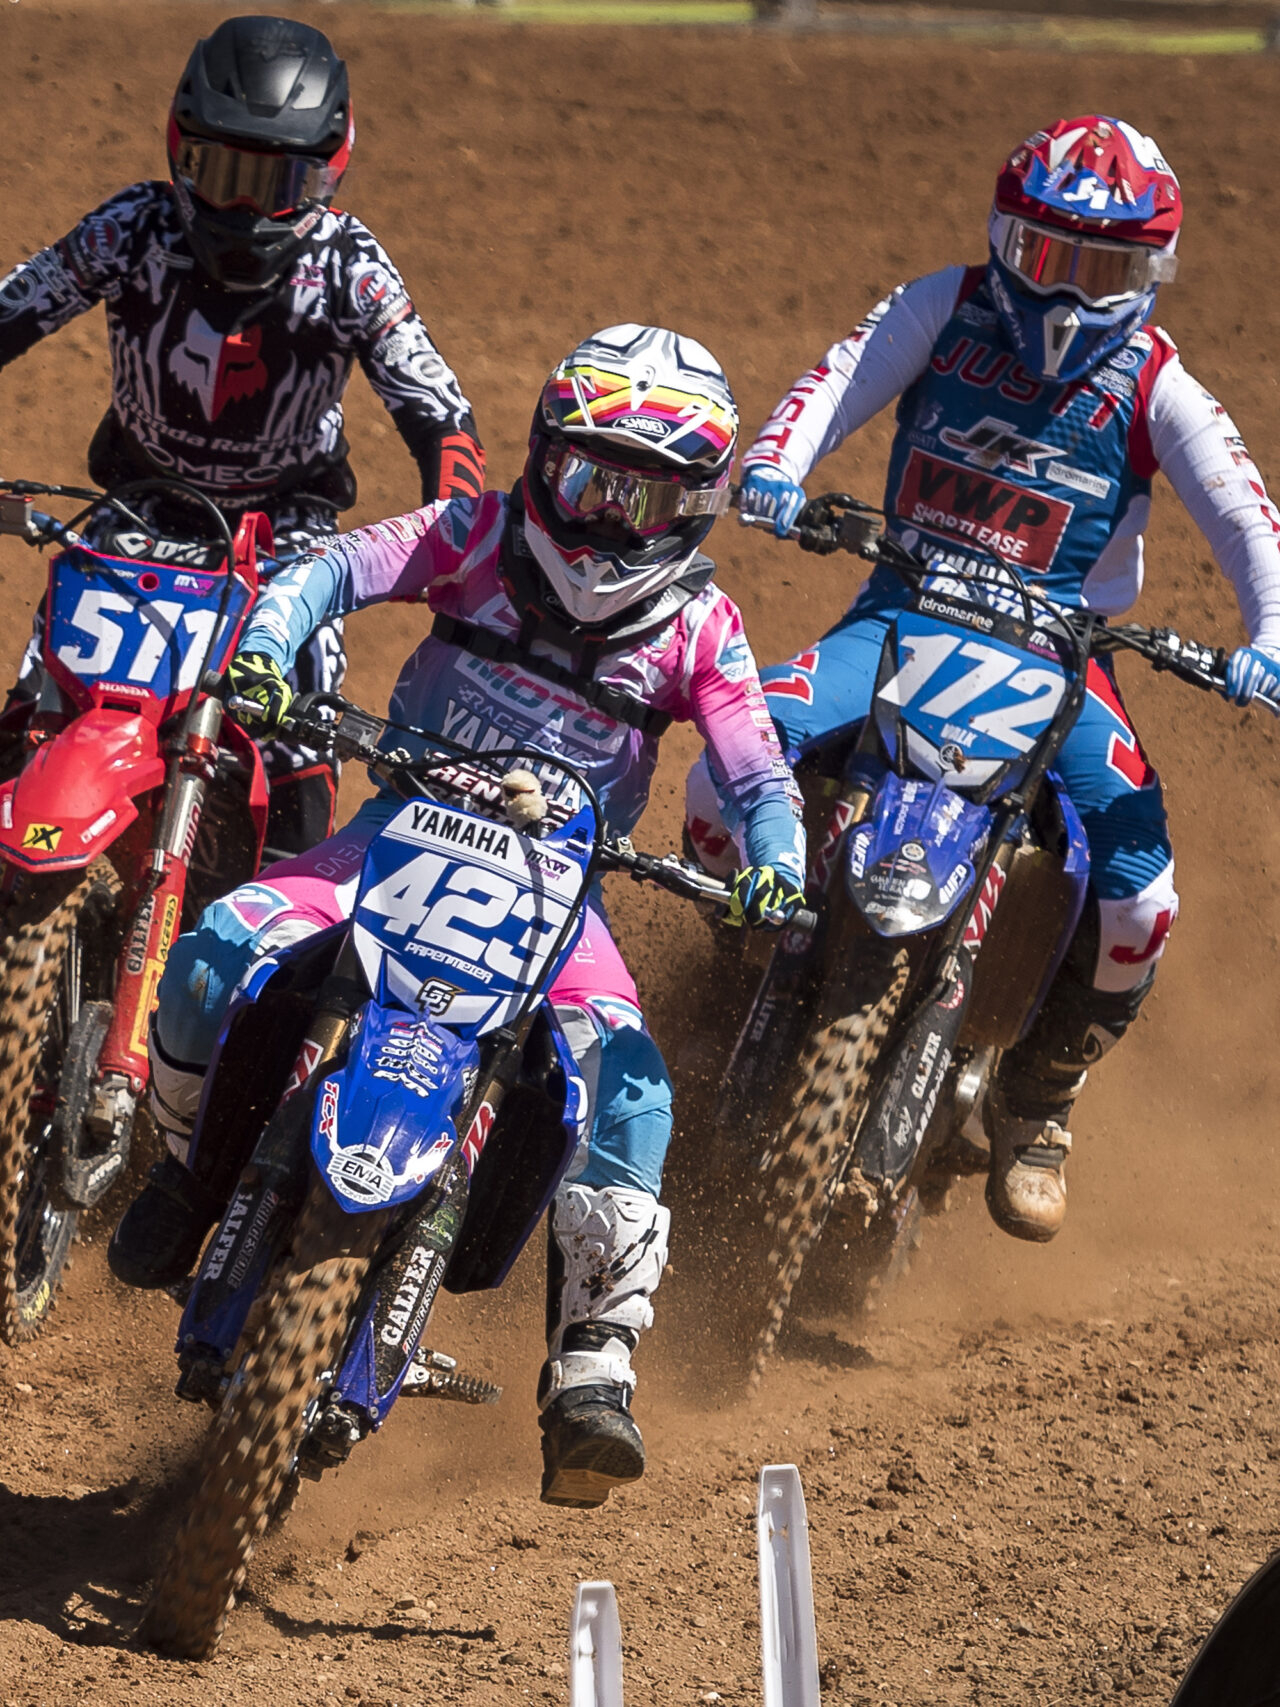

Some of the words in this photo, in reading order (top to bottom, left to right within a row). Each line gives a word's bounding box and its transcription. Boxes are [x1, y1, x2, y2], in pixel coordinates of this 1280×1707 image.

[619, 417, 665, 436] SHOEI
[914, 458, 1050, 533] VWP
[57, 589, 229, 692] 511
[98, 681, 151, 698] HONDA
[877, 632, 1067, 754] 172
[410, 804, 511, 860] YAMAHA
[160, 897, 177, 960] ACERBIS
[359, 851, 581, 987] 423
[910, 1030, 942, 1099] GALFER
[319, 1081, 339, 1138] TCX
[342, 1160, 384, 1190] EMA
[380, 1246, 435, 1346] GALFER
